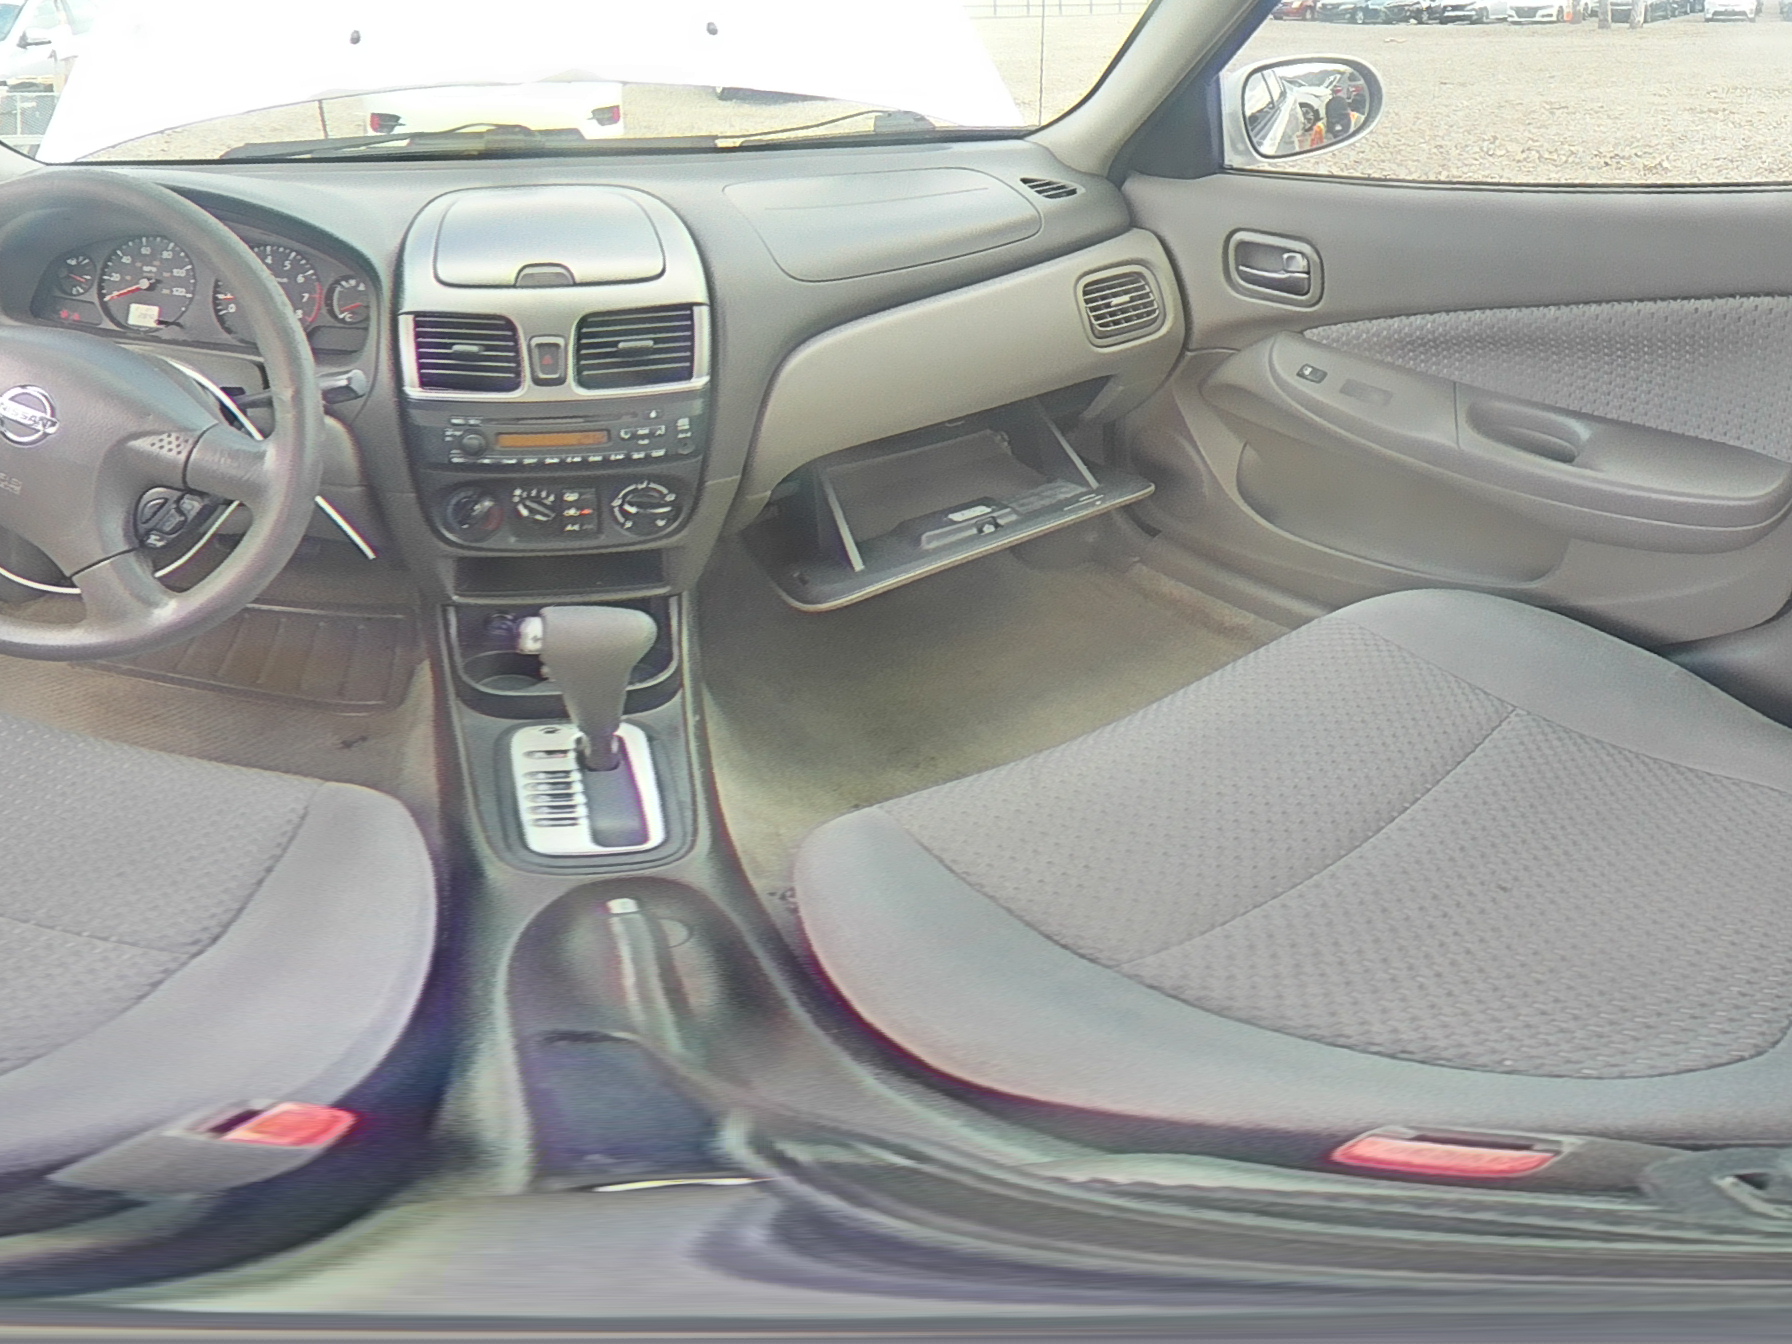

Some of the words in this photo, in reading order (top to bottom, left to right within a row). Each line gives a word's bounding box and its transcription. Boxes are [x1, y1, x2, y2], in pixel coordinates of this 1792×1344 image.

[283, 261, 291, 270] 5
[296, 274, 306, 283] 6
[301, 293, 310, 302] 7
